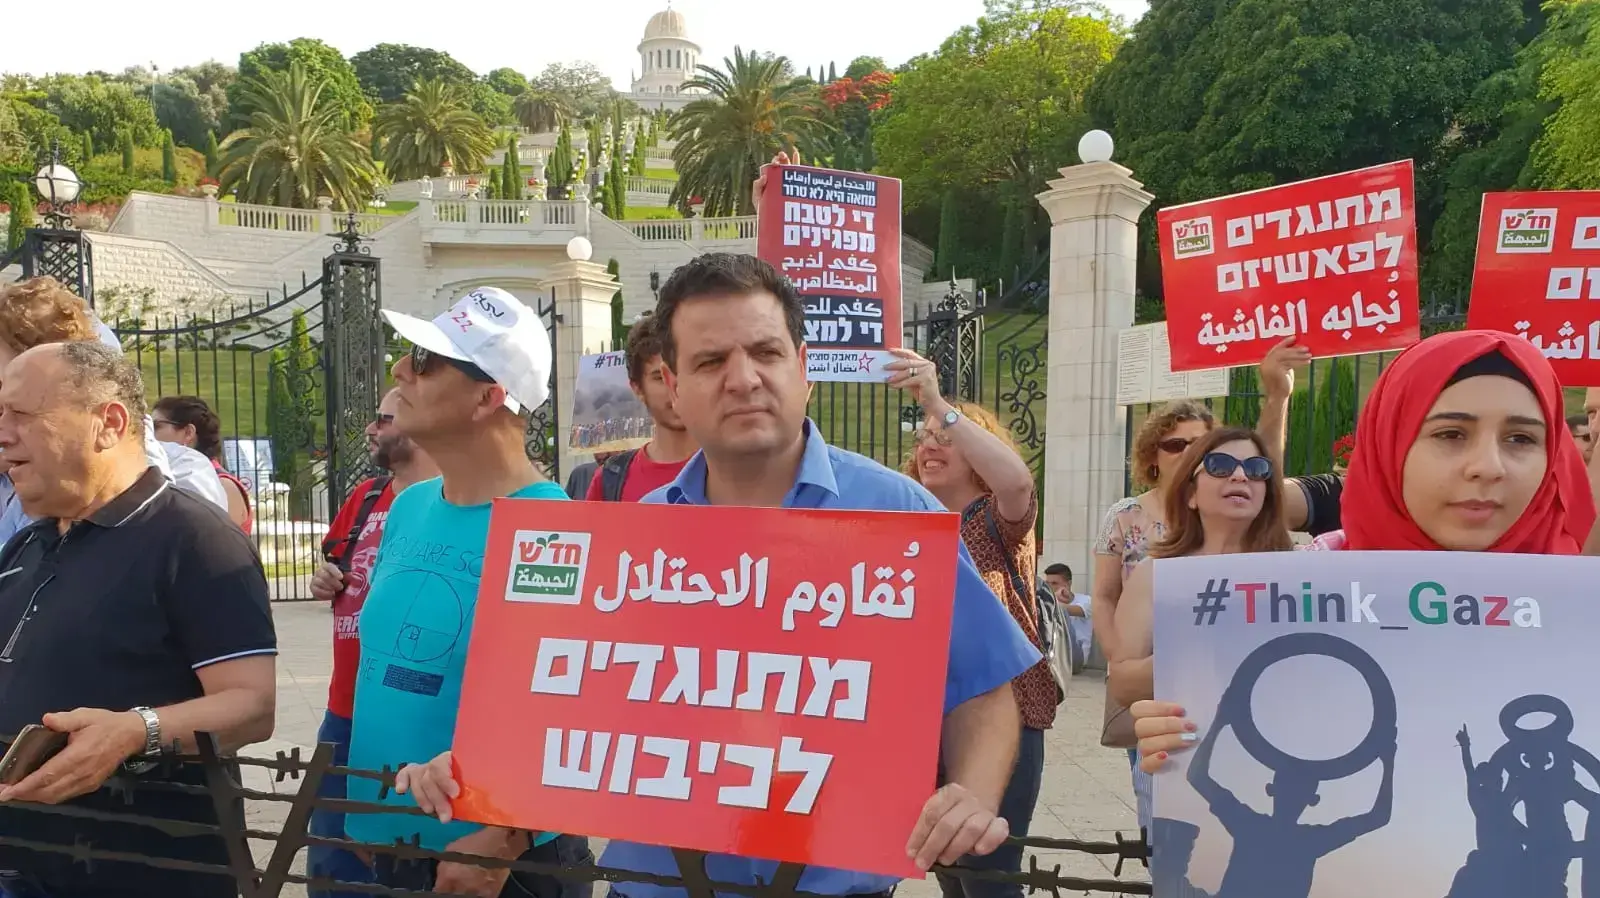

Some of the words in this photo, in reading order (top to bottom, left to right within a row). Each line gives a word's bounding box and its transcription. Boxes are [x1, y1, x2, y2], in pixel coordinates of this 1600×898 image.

[783, 184, 807, 197] טרור
[809, 187, 823, 199] לא
[826, 189, 844, 203] היא
[847, 192, 876, 206] מחאה
[784, 201, 846, 227] לטבח
[852, 209, 874, 231] די
[1226, 187, 1401, 248] מתנגדים
[783, 224, 875, 253] מפגינים
[1504, 232, 1547, 246] الجبهة
[782, 251, 823, 271] لذبح
[1216, 232, 1404, 293] לפאשיזם
[803, 316, 853, 342] למצ
[860, 321, 883, 343] די
[1197, 298, 1308, 354] الفاشية
[806, 353, 830, 361] סוציא
[831, 353, 858, 362] מאבק
[415, 541, 456, 567] ARE
[516, 568, 575, 592] الجبهة
[593, 547, 769, 613] الاحتلال
[1192, 577, 1542, 631] #Think_Gaza
[529, 637, 872, 721] מתנגדים
[541, 726, 834, 815] לכיבוש
